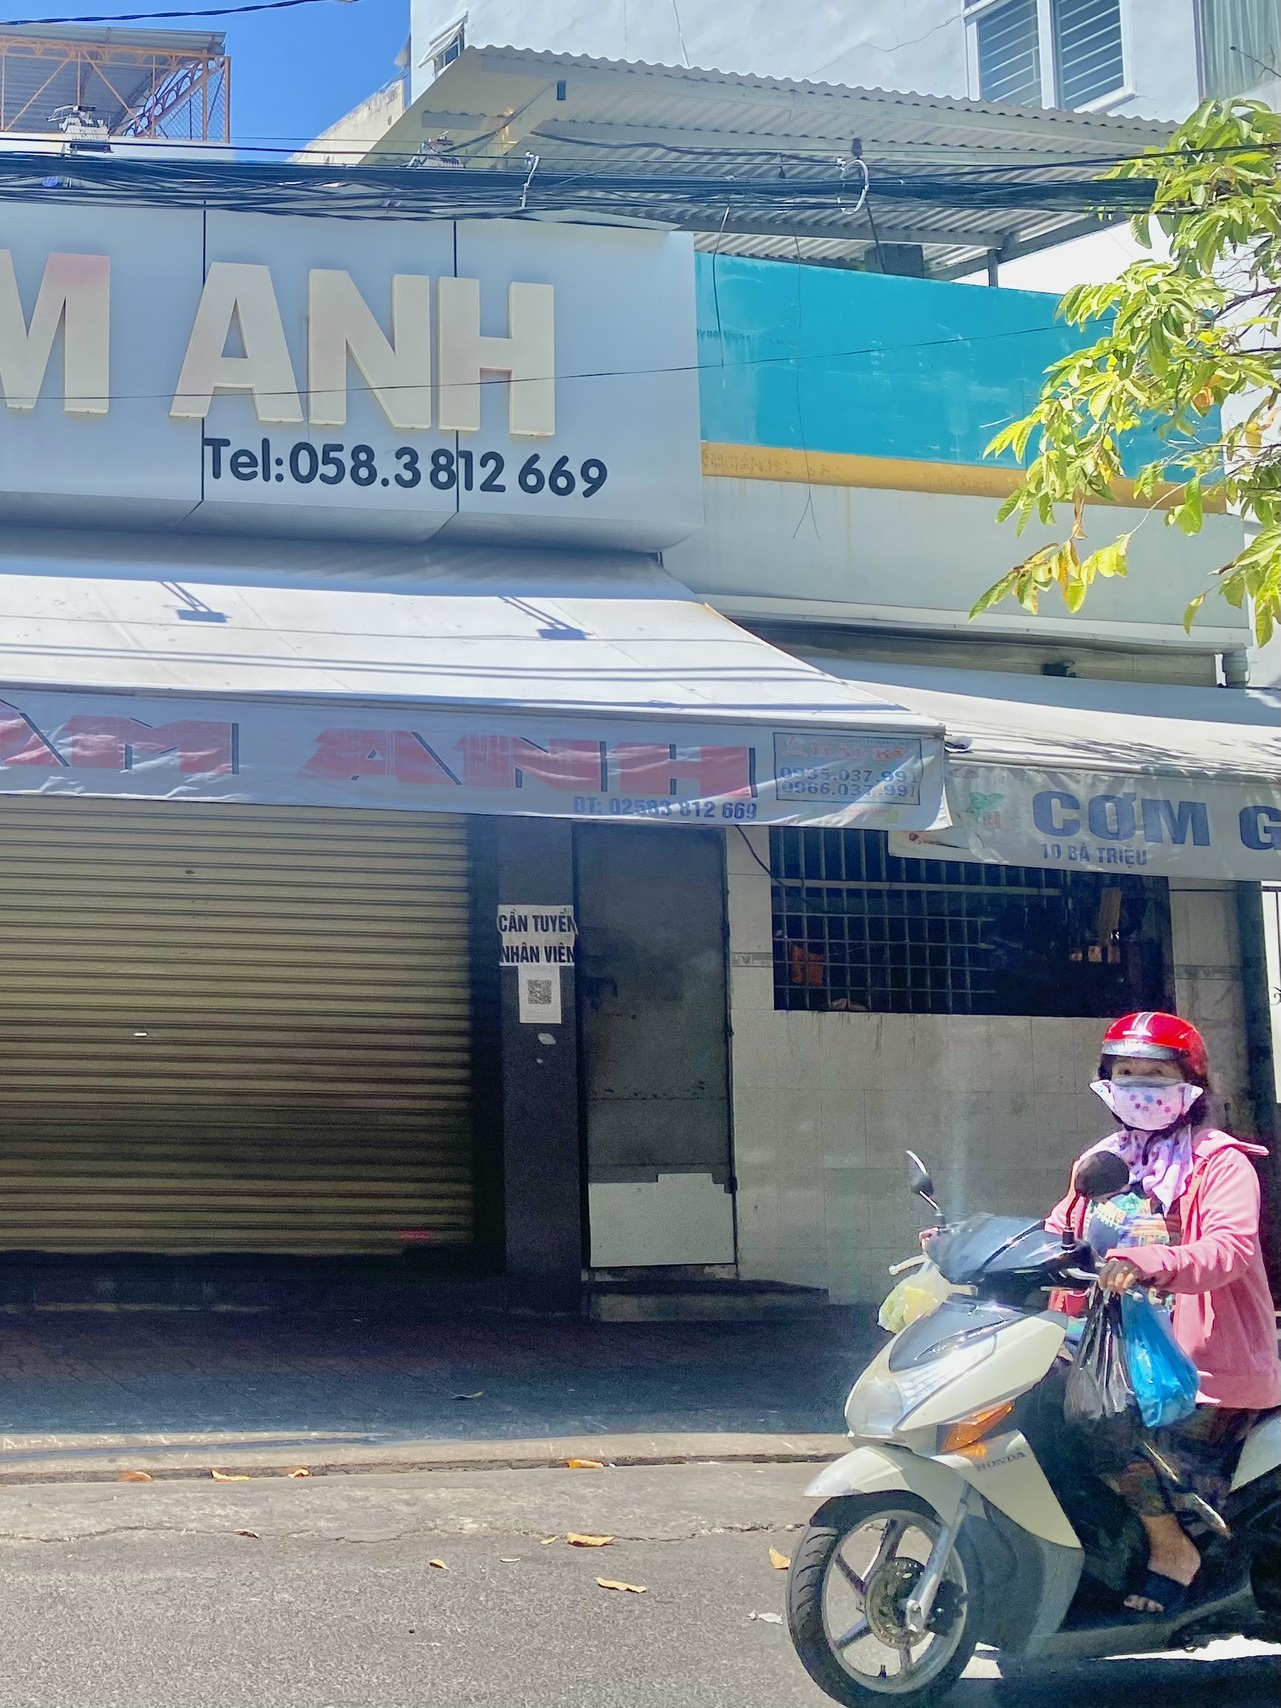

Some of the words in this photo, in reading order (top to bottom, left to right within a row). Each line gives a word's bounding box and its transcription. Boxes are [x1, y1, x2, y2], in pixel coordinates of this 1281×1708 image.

[169, 260, 556, 438] ANH
[297, 727, 759, 799] ANH
[679, 799, 716, 819] 812
[721, 800, 758, 820] 669
[1031, 789, 1211, 847] CƠM
[1040, 842, 1062, 860] 10
[1067, 841, 1090, 864] BÀ
[1096, 846, 1148, 869] TRIỆU
[498, 908, 528, 932] CẦN
[501, 941, 541, 963] NHÂN
[544, 941, 575, 963] VIÊN
[975, 1451, 1027, 1472] HONDA
